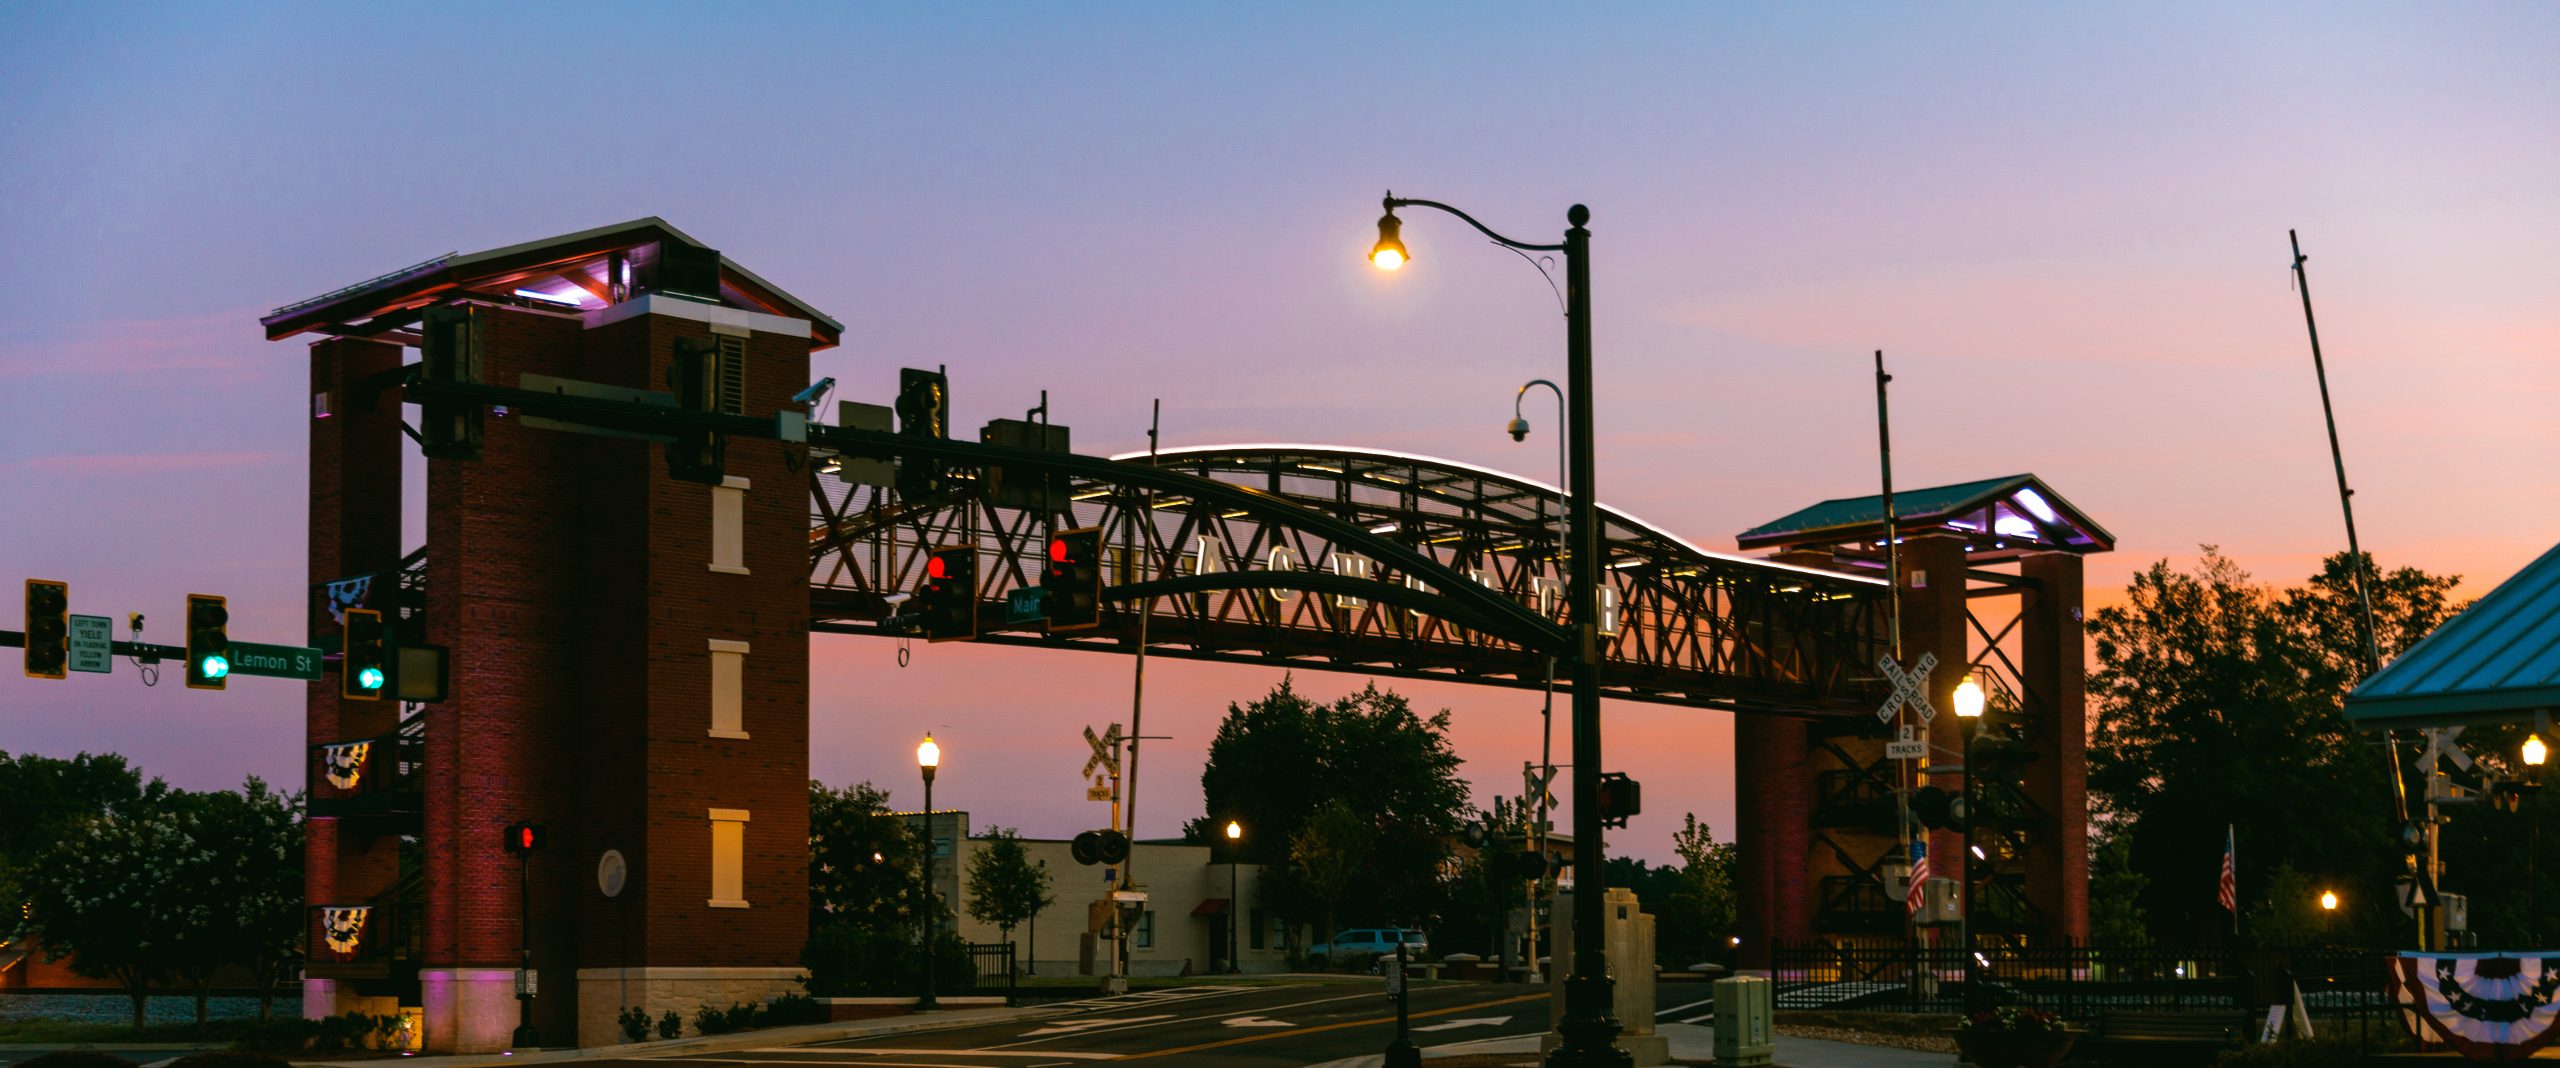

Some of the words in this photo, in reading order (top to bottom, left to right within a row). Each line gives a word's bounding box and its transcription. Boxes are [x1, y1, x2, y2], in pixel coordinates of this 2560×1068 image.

[1195, 535, 1623, 637] ACWTH
[1013, 595, 1041, 614] Main
[234, 649, 288, 670] Lemon
[295, 655, 312, 672] St
[1903, 727, 1910, 739] 2
[1891, 744, 1922, 755] TRACKS
